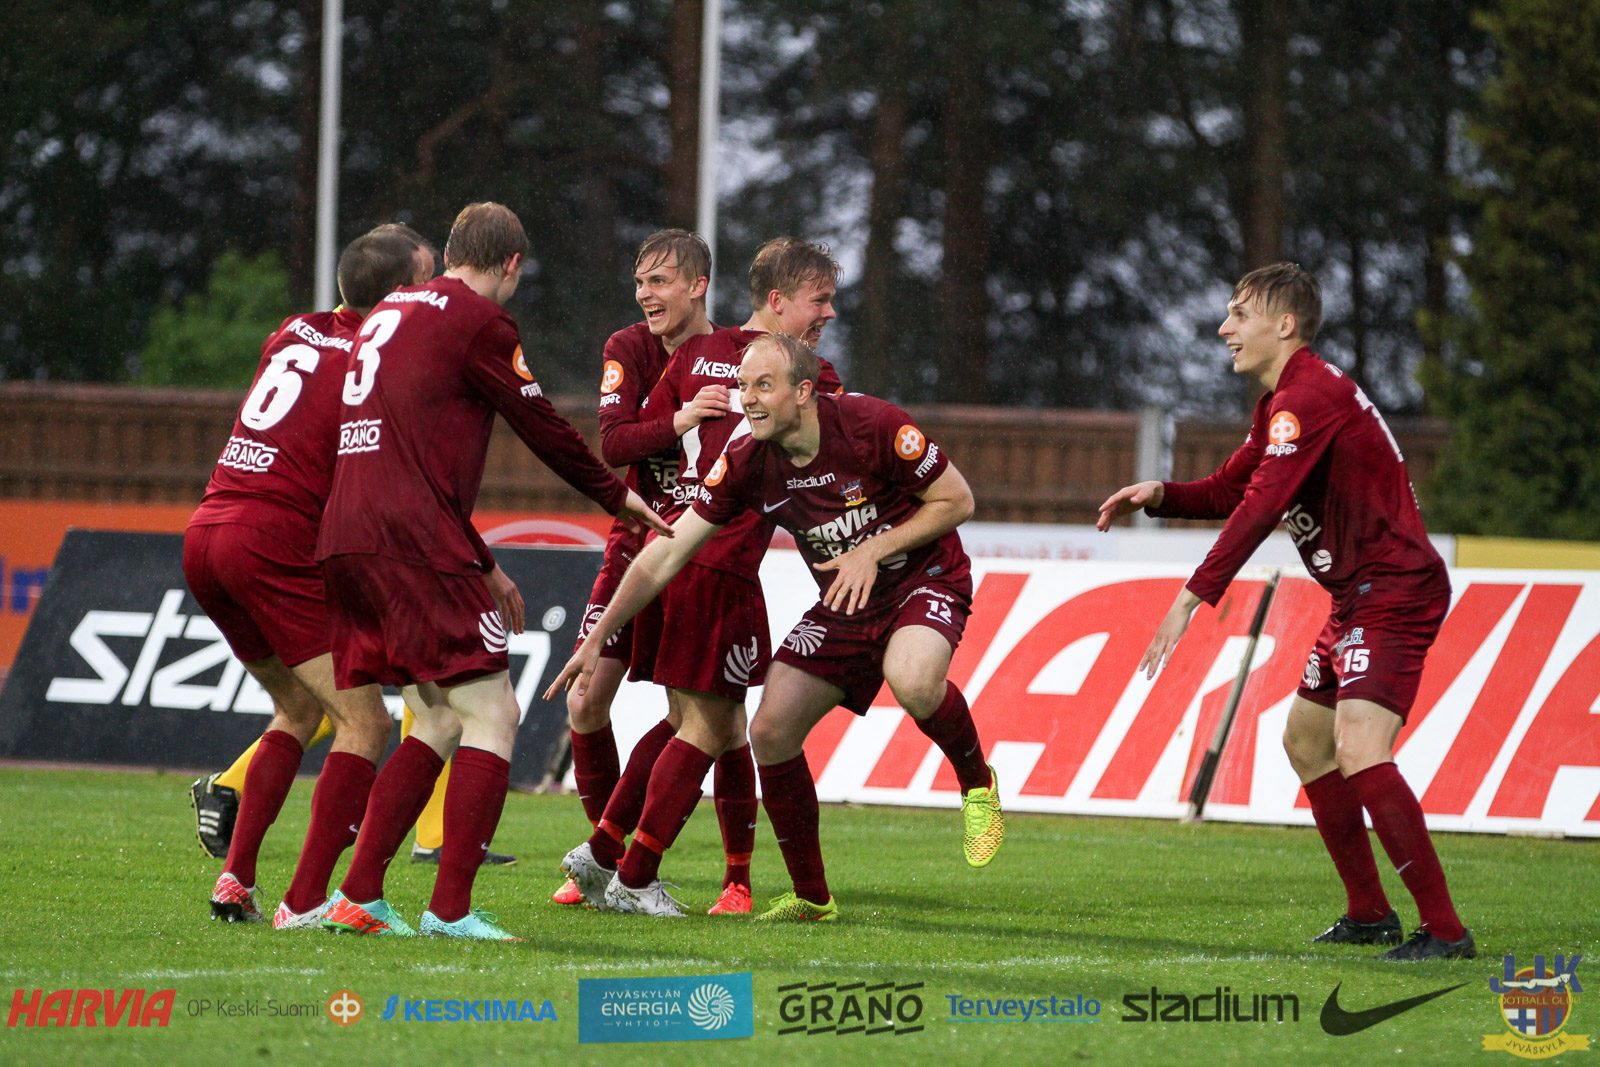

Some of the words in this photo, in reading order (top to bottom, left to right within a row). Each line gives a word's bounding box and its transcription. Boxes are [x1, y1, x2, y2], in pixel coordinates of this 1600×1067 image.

[289, 318, 353, 353] KESKIMA
[342, 309, 401, 406] 3
[700, 359, 740, 378] KESK
[240, 344, 320, 431] 6
[340, 425, 380, 449] RANO
[786, 472, 836, 490] stadium
[799, 503, 878, 543] ARVIA
[926, 599, 952, 624] 12
[1343, 648, 1370, 673] 15
